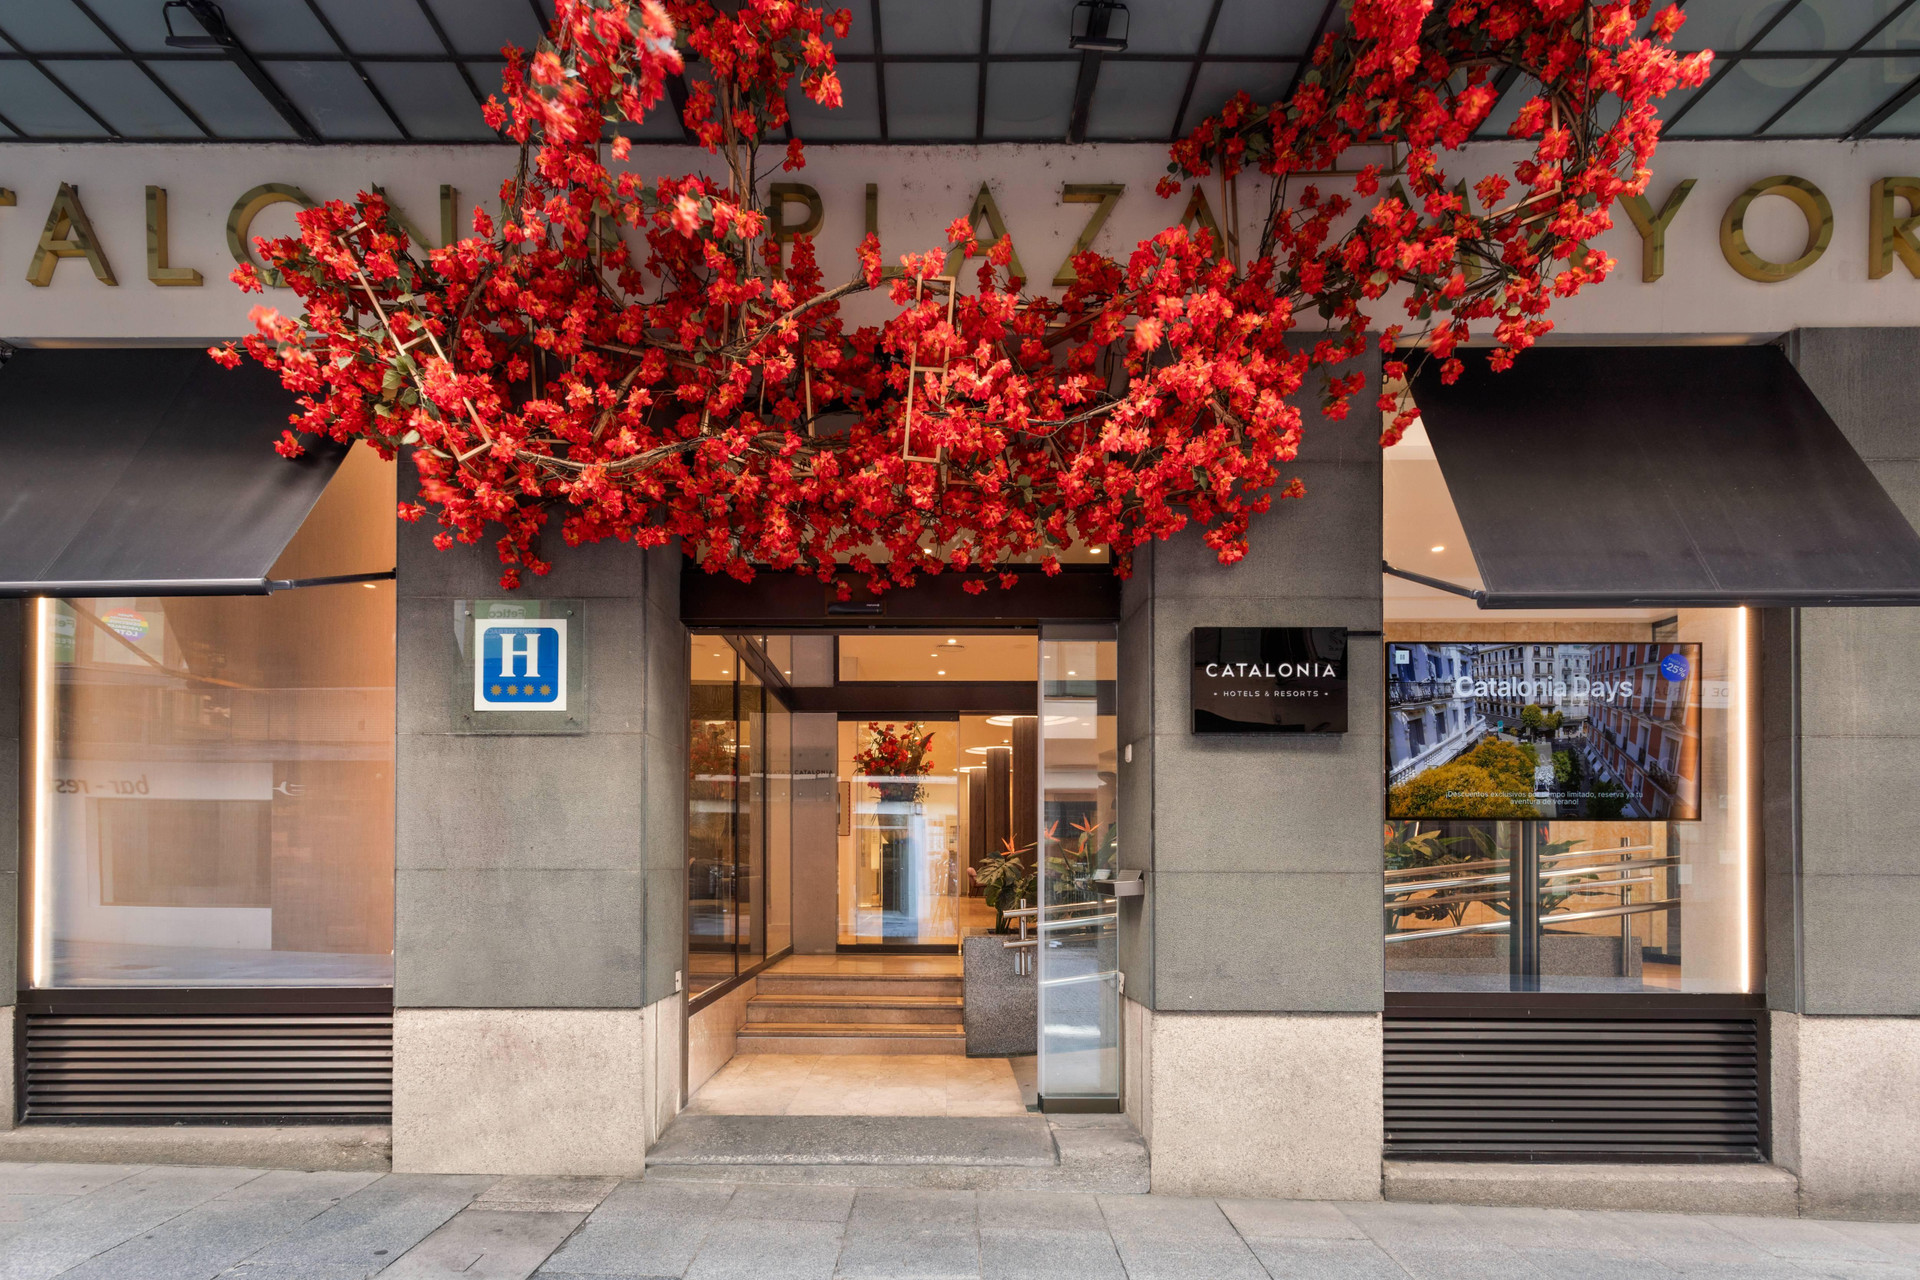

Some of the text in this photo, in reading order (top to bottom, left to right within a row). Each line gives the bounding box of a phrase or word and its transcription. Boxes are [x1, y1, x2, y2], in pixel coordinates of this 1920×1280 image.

[499, 633, 541, 678] H
[1205, 662, 1336, 678] CATALONIA
[1663, 662, 1686, 678] -25%
[1455, 675, 1633, 703] Catalonia Days
